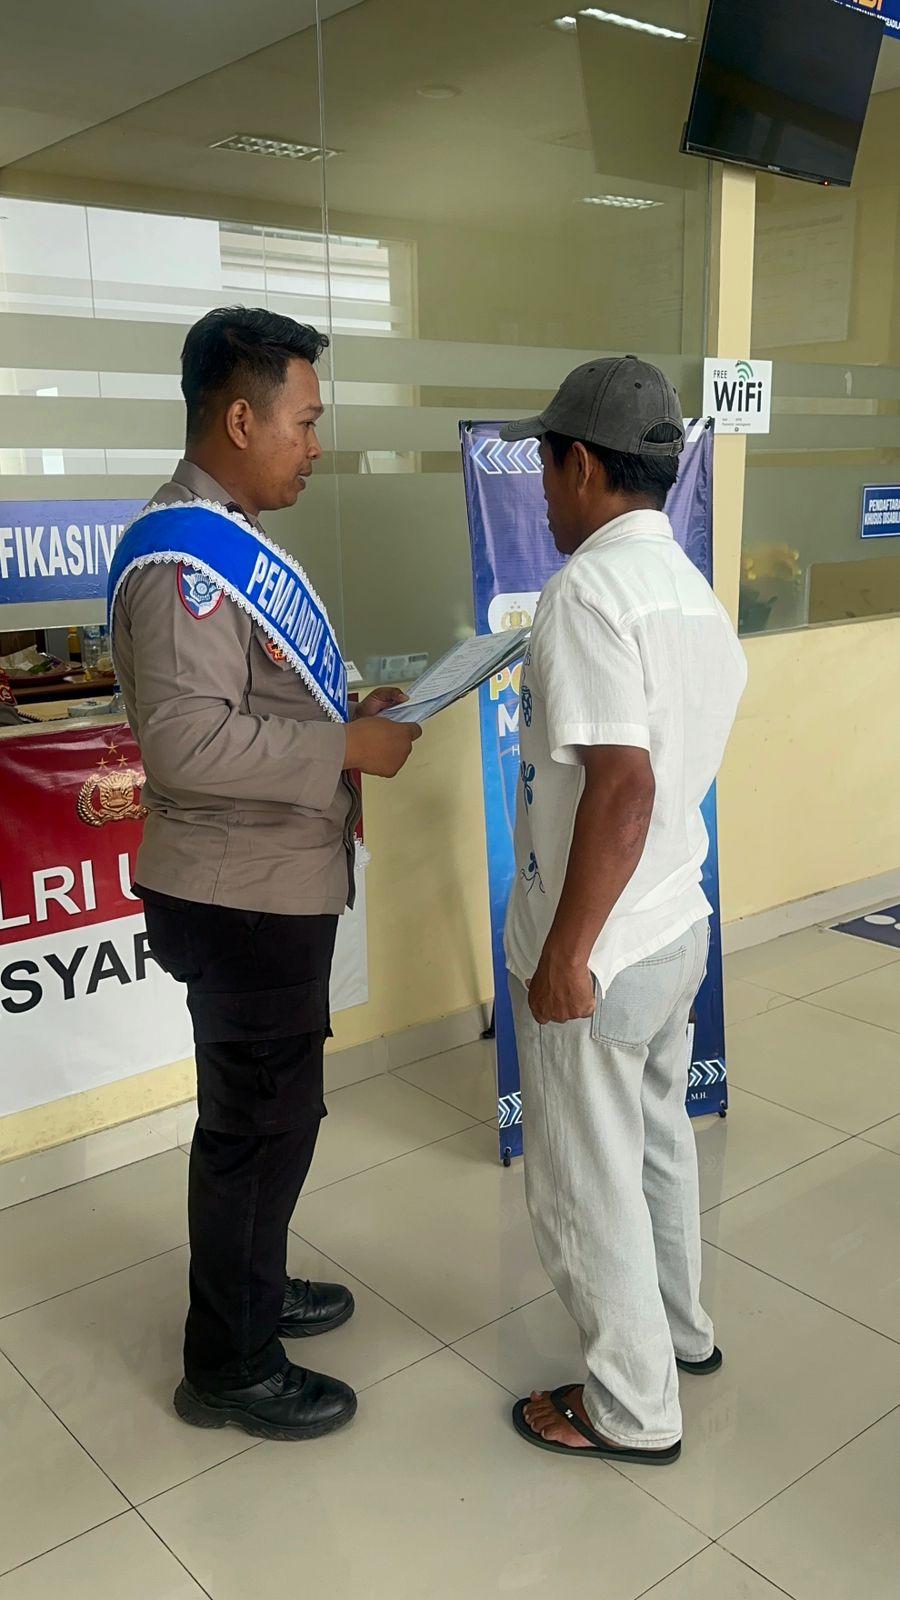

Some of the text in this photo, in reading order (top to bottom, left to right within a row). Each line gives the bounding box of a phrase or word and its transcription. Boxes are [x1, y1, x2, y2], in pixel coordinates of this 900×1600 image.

[713, 369, 728, 379] FREE
[713, 380, 763, 412] WiFi
[246, 550, 325, 667] PEMANDU
